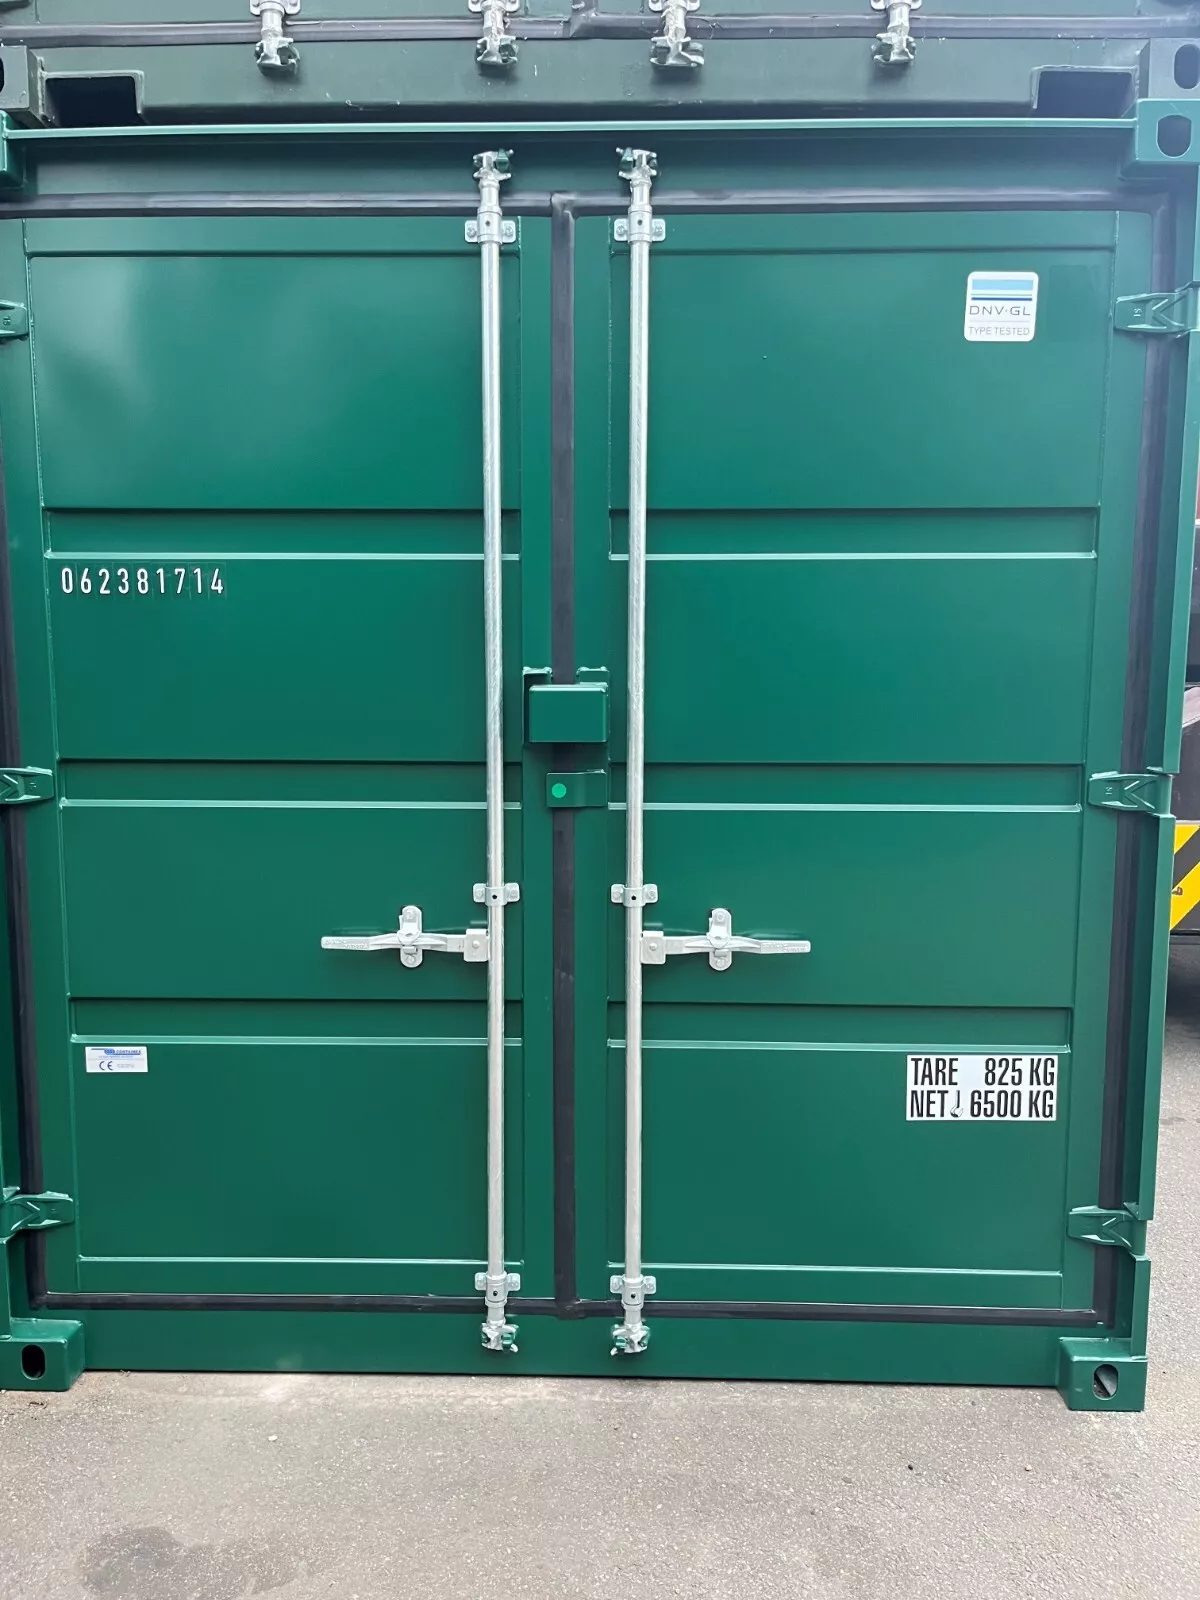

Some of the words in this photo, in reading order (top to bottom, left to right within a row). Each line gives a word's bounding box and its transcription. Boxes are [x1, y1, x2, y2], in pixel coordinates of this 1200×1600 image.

[968, 326, 992, 335] TYPE
[994, 326, 1030, 336] TESTED
[61, 567, 224, 595] 062381714
[910, 1057, 959, 1086] TARE
[984, 1057, 1023, 1086] 825
[1029, 1057, 1055, 1086] KG
[910, 1089, 949, 1118] NET
[969, 1089, 1022, 1118] 6500
[1028, 1089, 1054, 1118] KG
